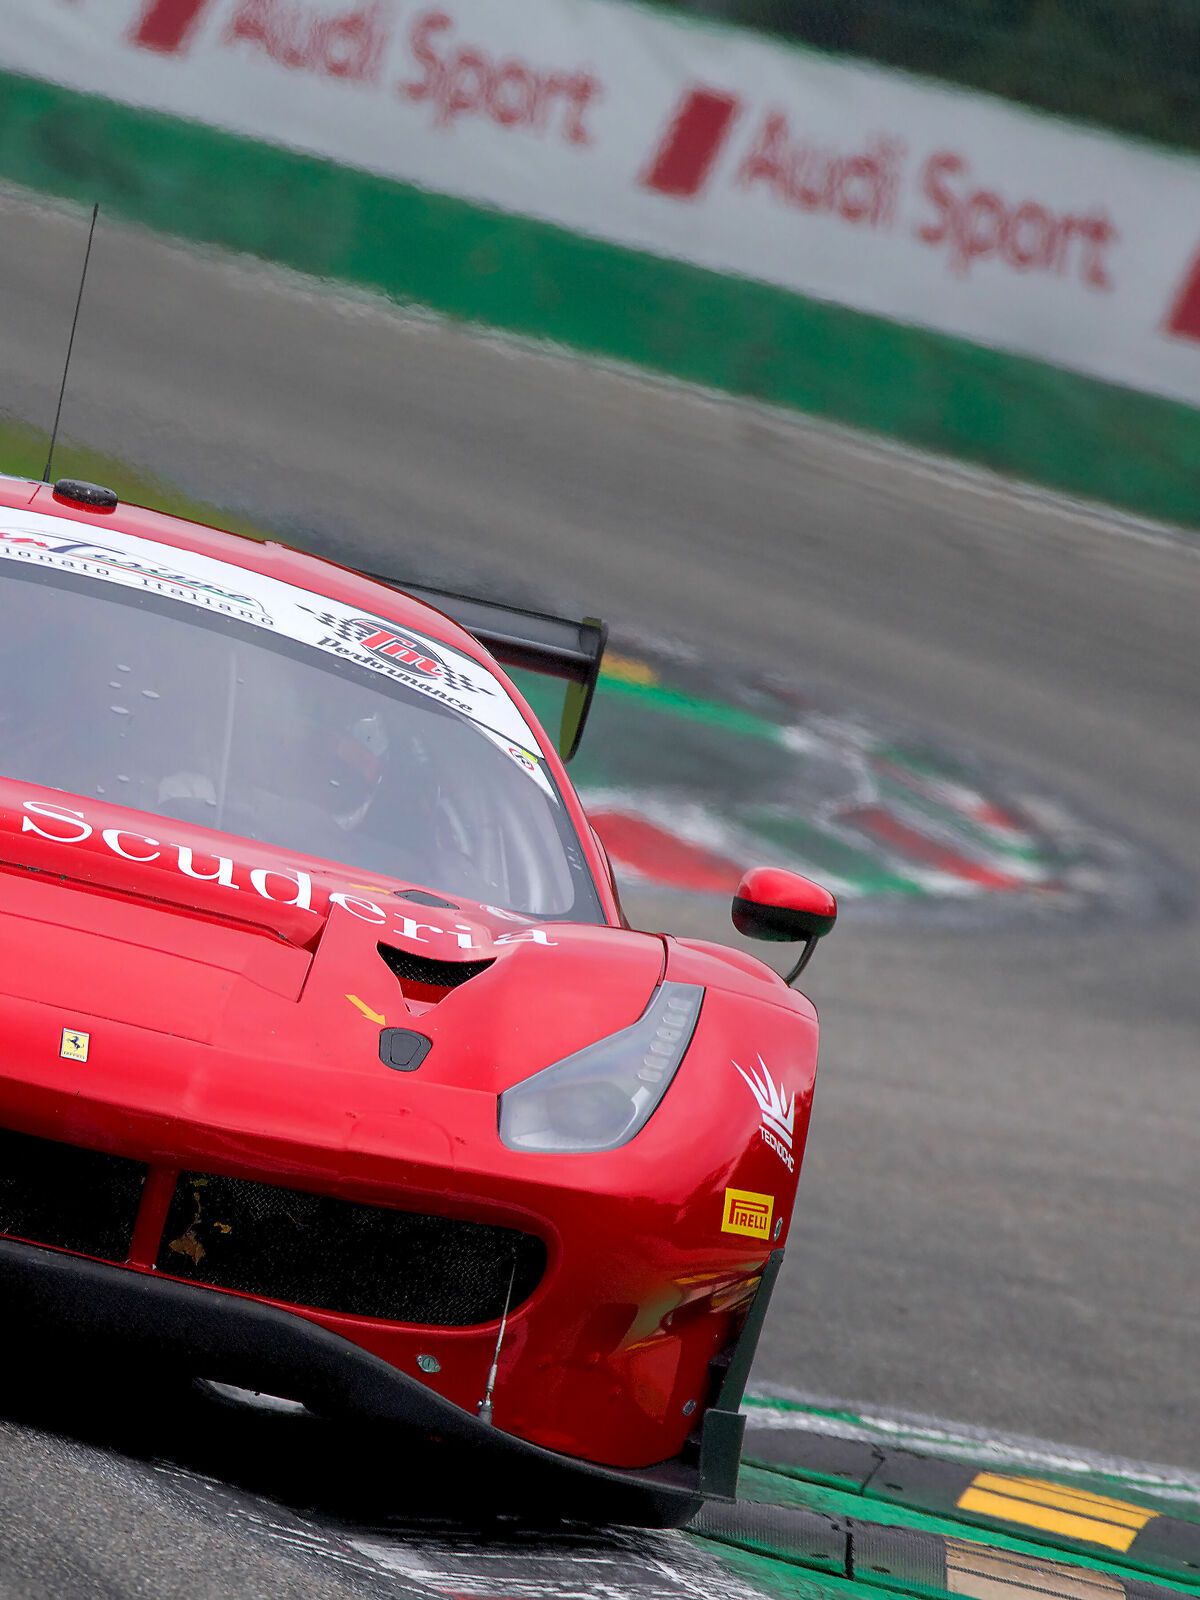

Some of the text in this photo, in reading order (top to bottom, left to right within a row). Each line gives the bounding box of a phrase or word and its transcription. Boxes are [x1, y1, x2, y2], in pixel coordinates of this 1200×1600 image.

[222, 0, 600, 145] Audi Sport
[735, 110, 1116, 285] Audi Sport
[142, 578, 275, 627] Italiano
[316, 636, 473, 712] Performance
[21, 799, 559, 949] Scuderia
[758, 1124, 795, 1174] TECNOCHIC
[728, 1198, 769, 1231] PIRELLI
